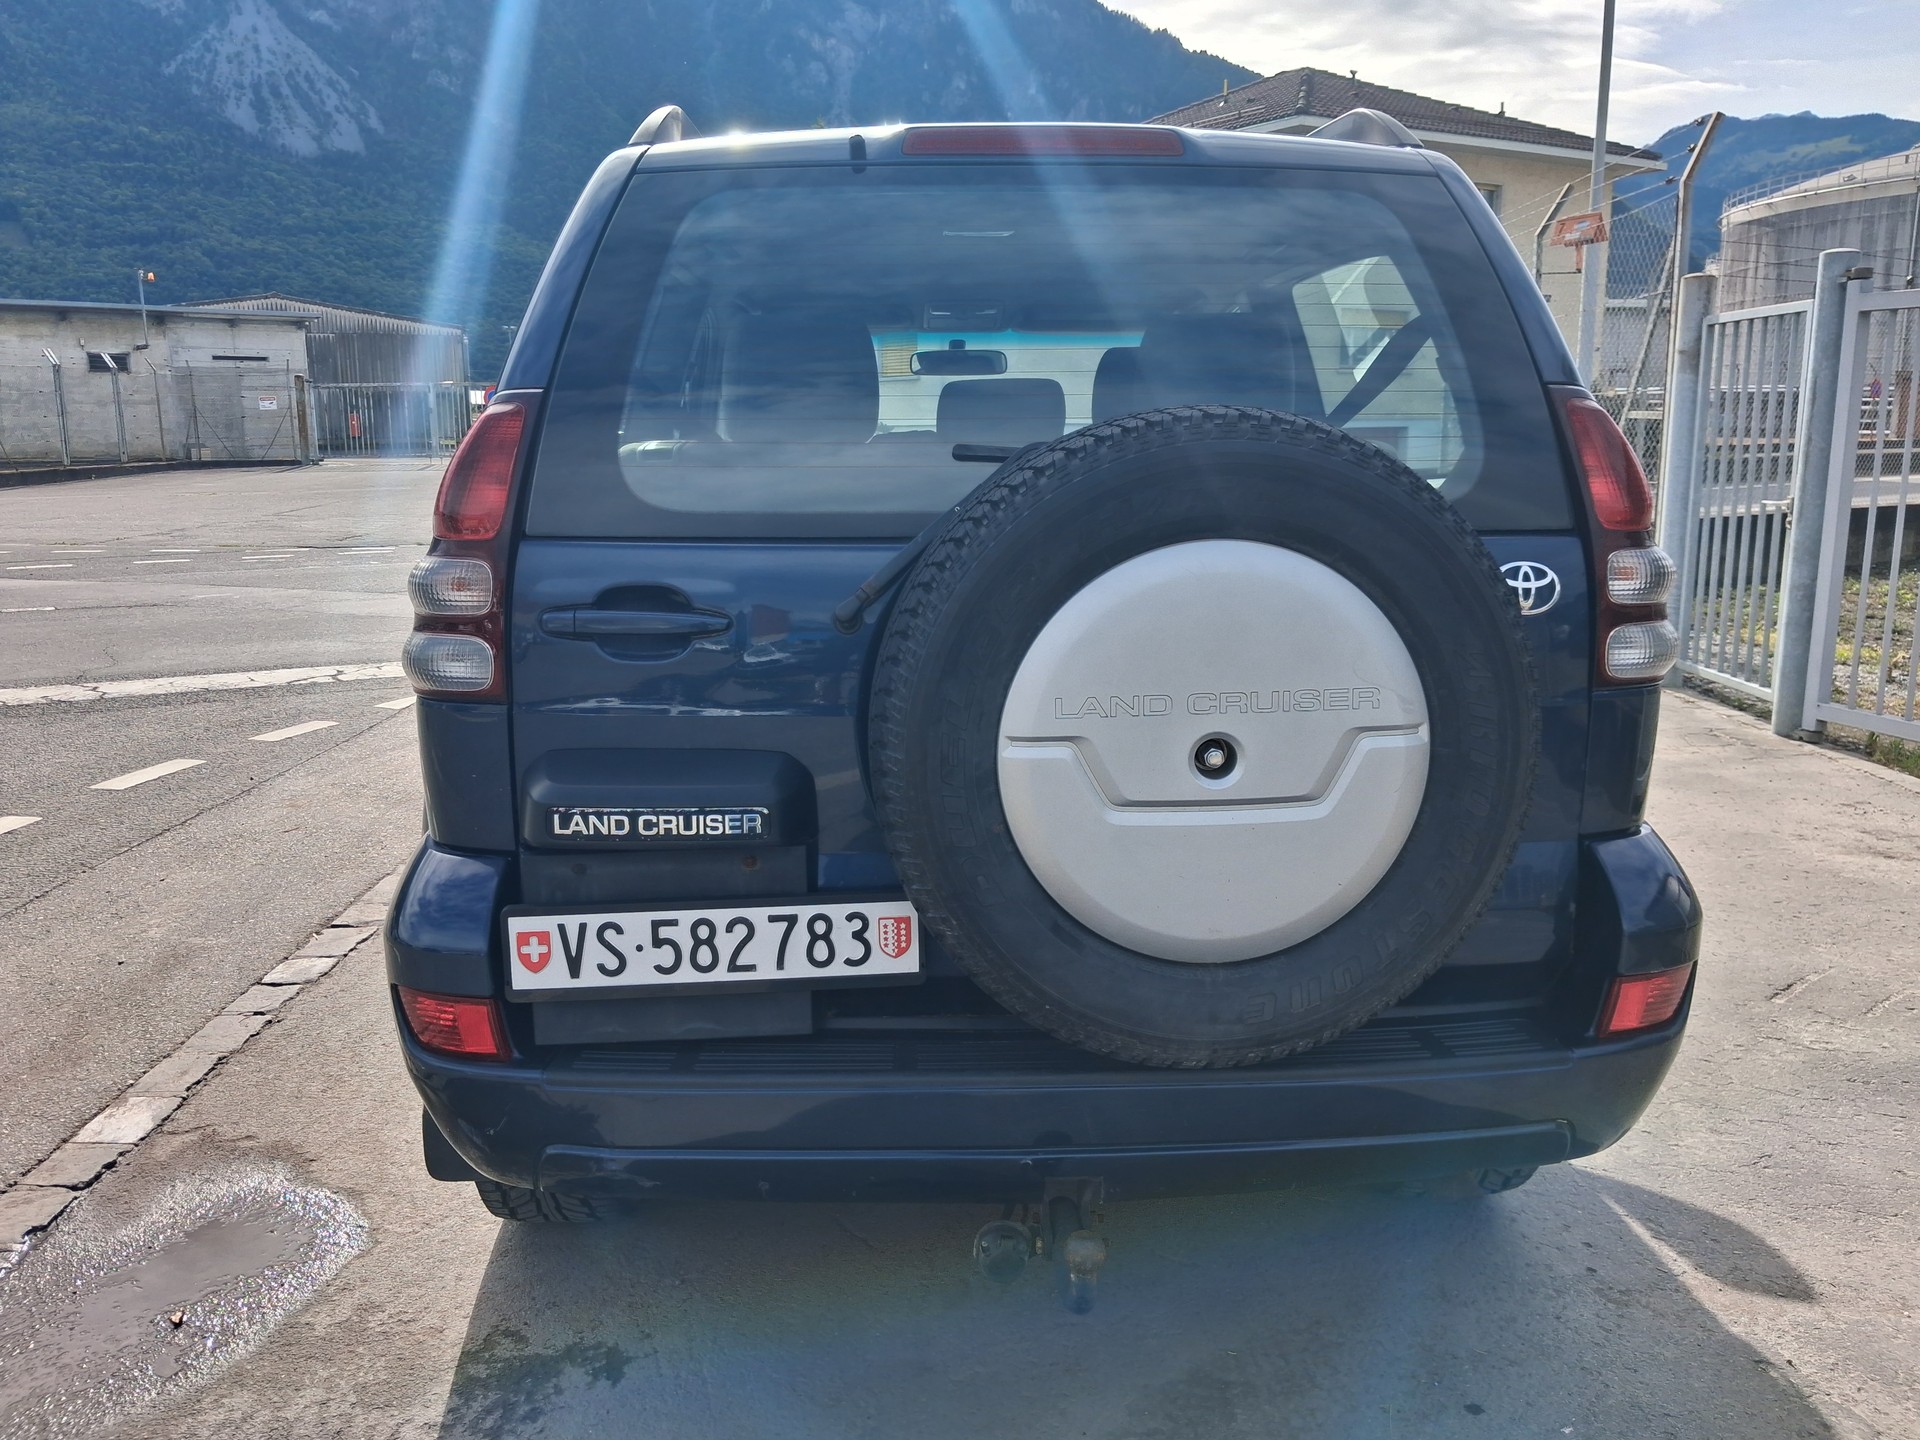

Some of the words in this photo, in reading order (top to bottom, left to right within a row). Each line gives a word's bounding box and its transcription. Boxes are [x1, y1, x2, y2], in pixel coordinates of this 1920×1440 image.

[1054, 694, 1174, 720] LAND
[1186, 687, 1382, 716] CRUISER
[553, 814, 630, 836] LAND
[638, 813, 762, 836] CRUISER
